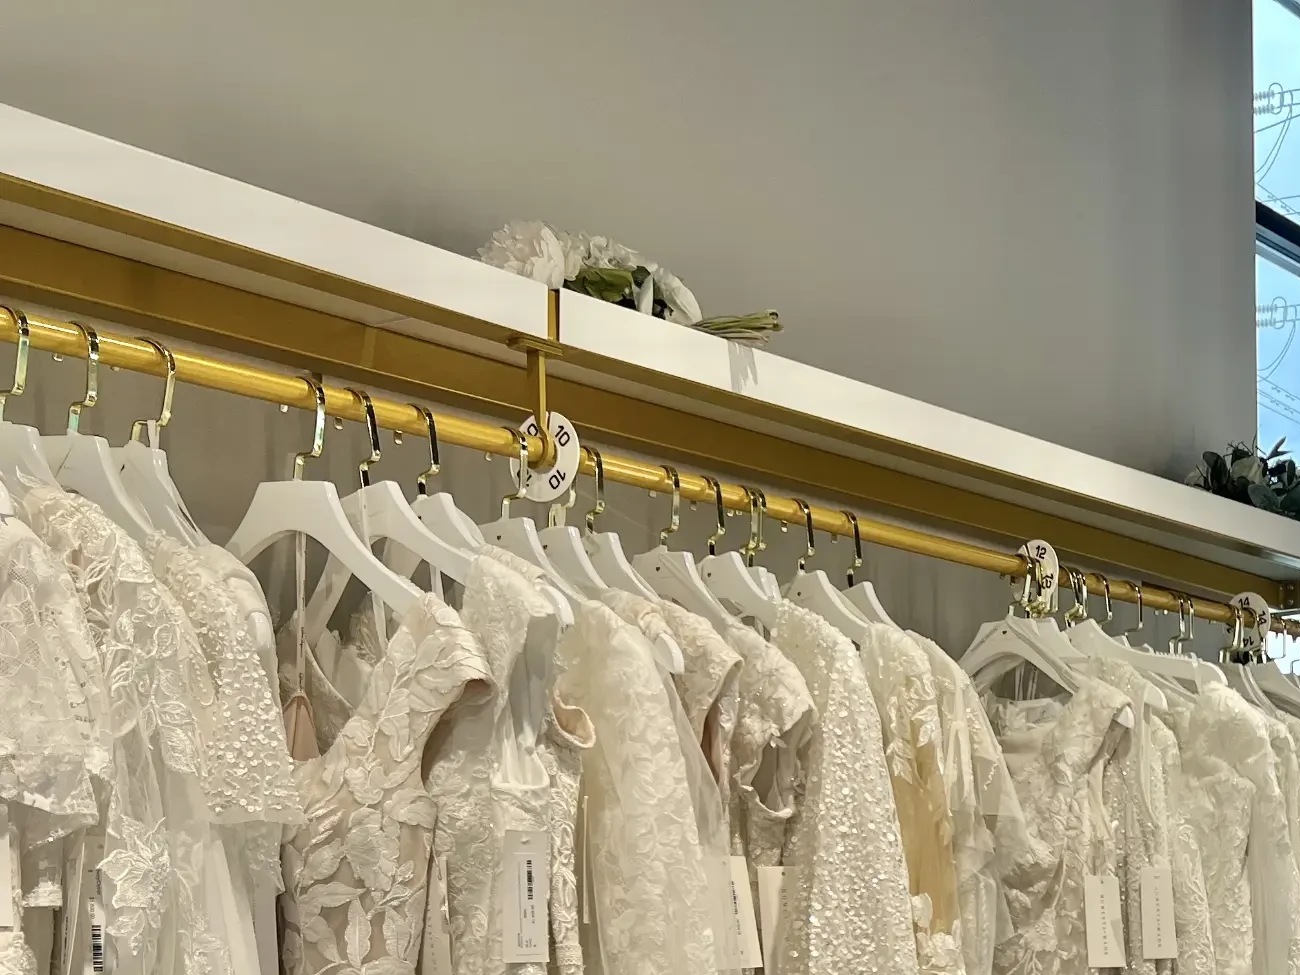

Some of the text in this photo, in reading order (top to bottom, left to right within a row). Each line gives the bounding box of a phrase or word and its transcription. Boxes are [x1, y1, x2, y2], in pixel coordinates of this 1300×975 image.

[554, 425, 571, 447] 10
[548, 469, 566, 490] 10
[1035, 545, 1047, 560] 12
[1238, 597, 1251, 609] 14
